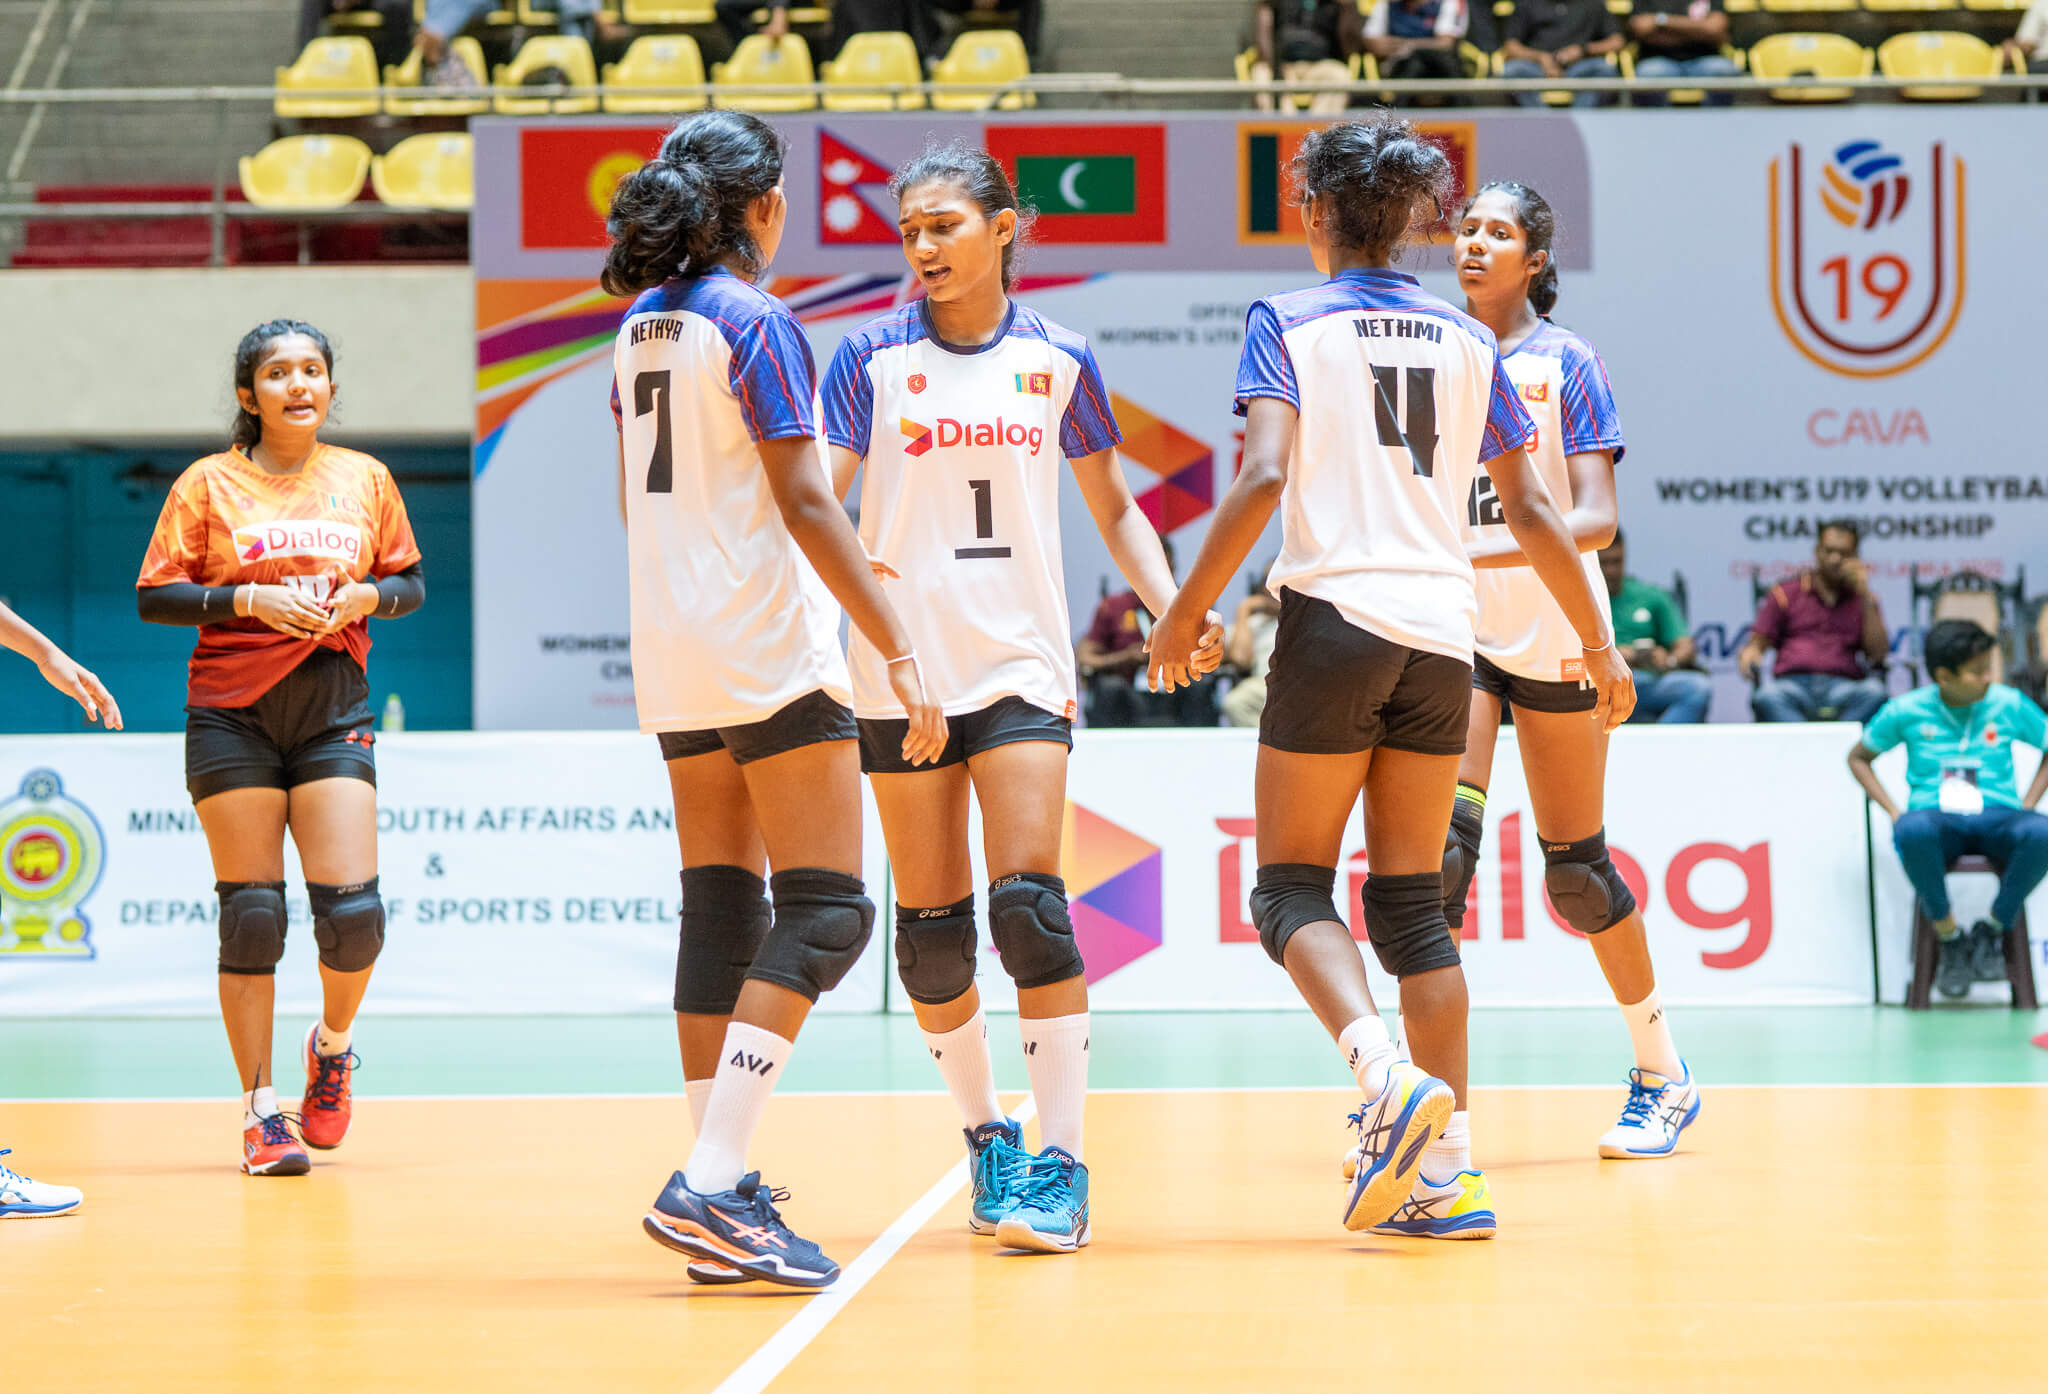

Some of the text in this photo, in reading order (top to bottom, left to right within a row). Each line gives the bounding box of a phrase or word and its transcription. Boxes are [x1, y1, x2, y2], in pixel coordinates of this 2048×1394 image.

[1820, 252, 1912, 323] 19
[630, 318, 684, 347] NETHYA
[1352, 318, 1443, 344] NETHMI
[634, 369, 672, 493] 7
[1369, 362, 1440, 478] 4
[1806, 408, 1930, 447] CAVA
[936, 415, 1044, 457] Dialog
[1655, 476, 2048, 502] WOMEN'S U19 VOLLEYBA
[967, 479, 993, 539] 1
[266, 526, 359, 560] Dialog
[127, 807, 673, 832] MINI OUTH AFFAIRS AN
[424, 852, 446, 878] &
[386, 899, 404, 923] F
[416, 898, 551, 923] SPORTS
[563, 898, 682, 924] DEVEL
[730, 1049, 774, 1077] AVI
